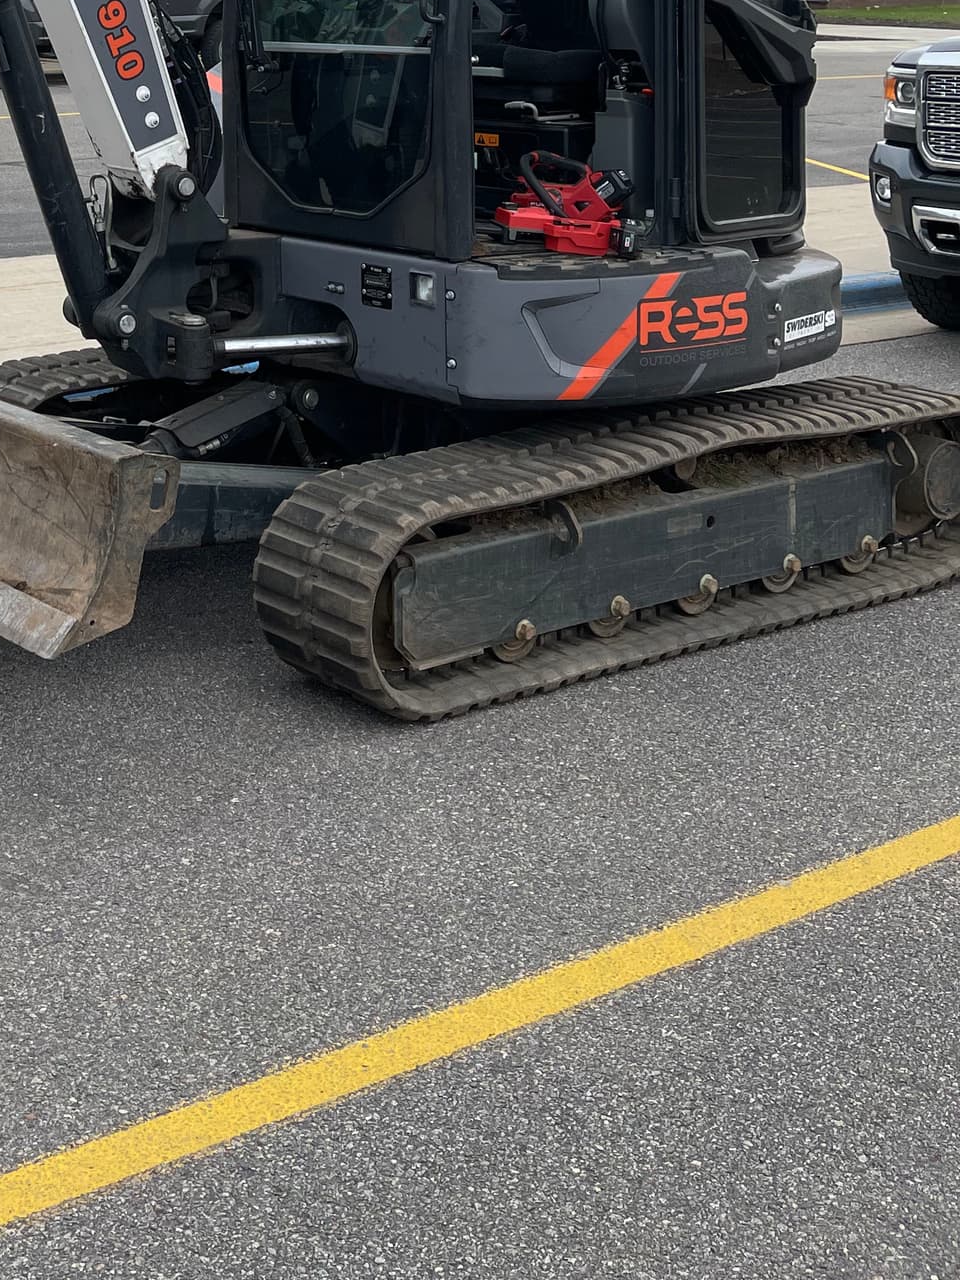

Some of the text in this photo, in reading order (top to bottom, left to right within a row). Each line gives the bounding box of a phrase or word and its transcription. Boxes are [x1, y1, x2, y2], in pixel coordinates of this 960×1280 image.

[786, 312, 824, 333] SWIDERSKI
[639, 343, 747, 368] OUTDOOR SERVICES
